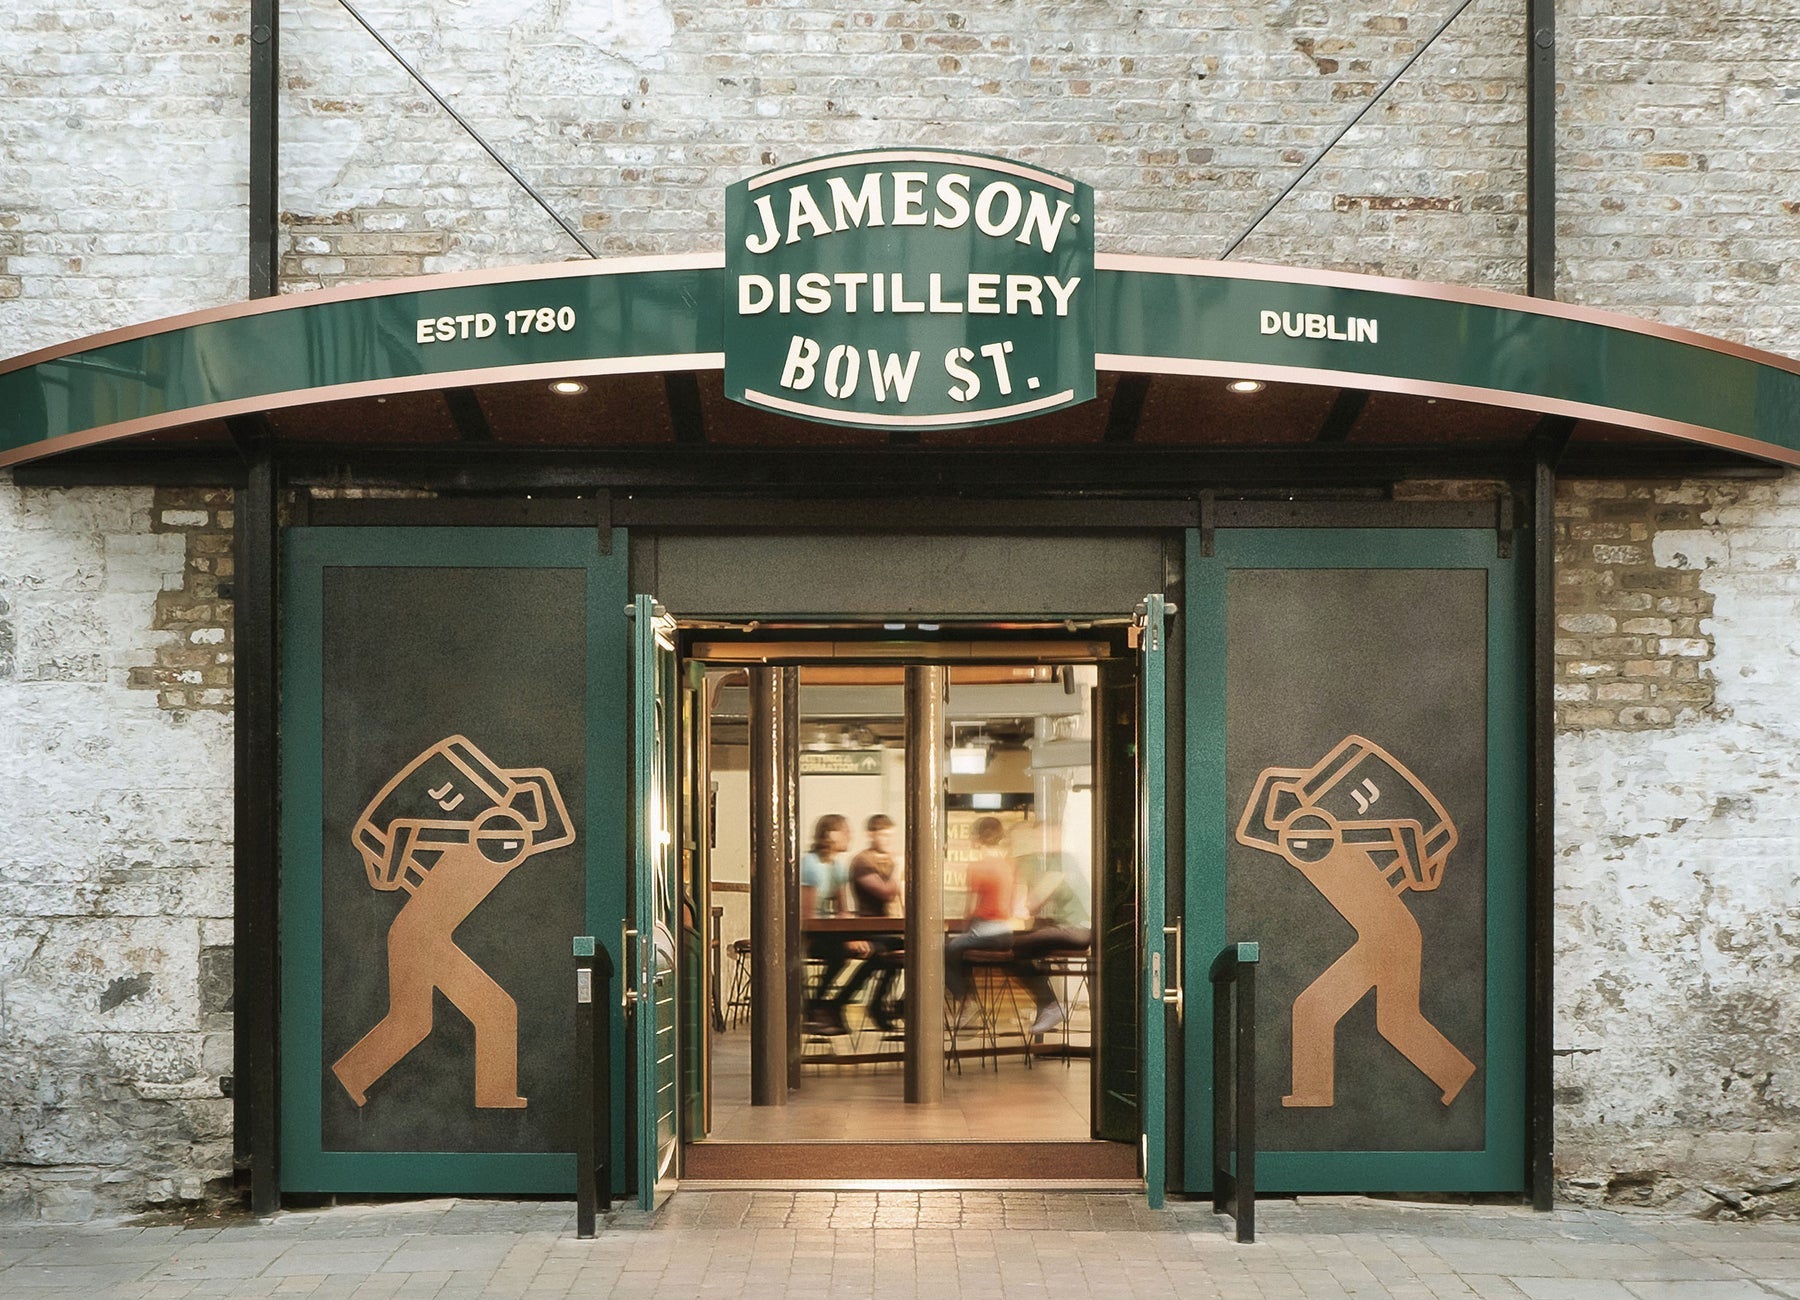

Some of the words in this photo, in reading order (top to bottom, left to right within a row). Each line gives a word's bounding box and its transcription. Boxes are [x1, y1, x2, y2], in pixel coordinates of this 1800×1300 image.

[745, 172, 1072, 254] JAMESON
[738, 273, 1081, 316] DISTILLERY
[416, 312, 497, 344] ESTD
[504, 306, 576, 335] 1780
[1260, 310, 1378, 343] DUBLIN
[780, 335, 921, 403] BOW
[944, 340, 1040, 402] ST.
